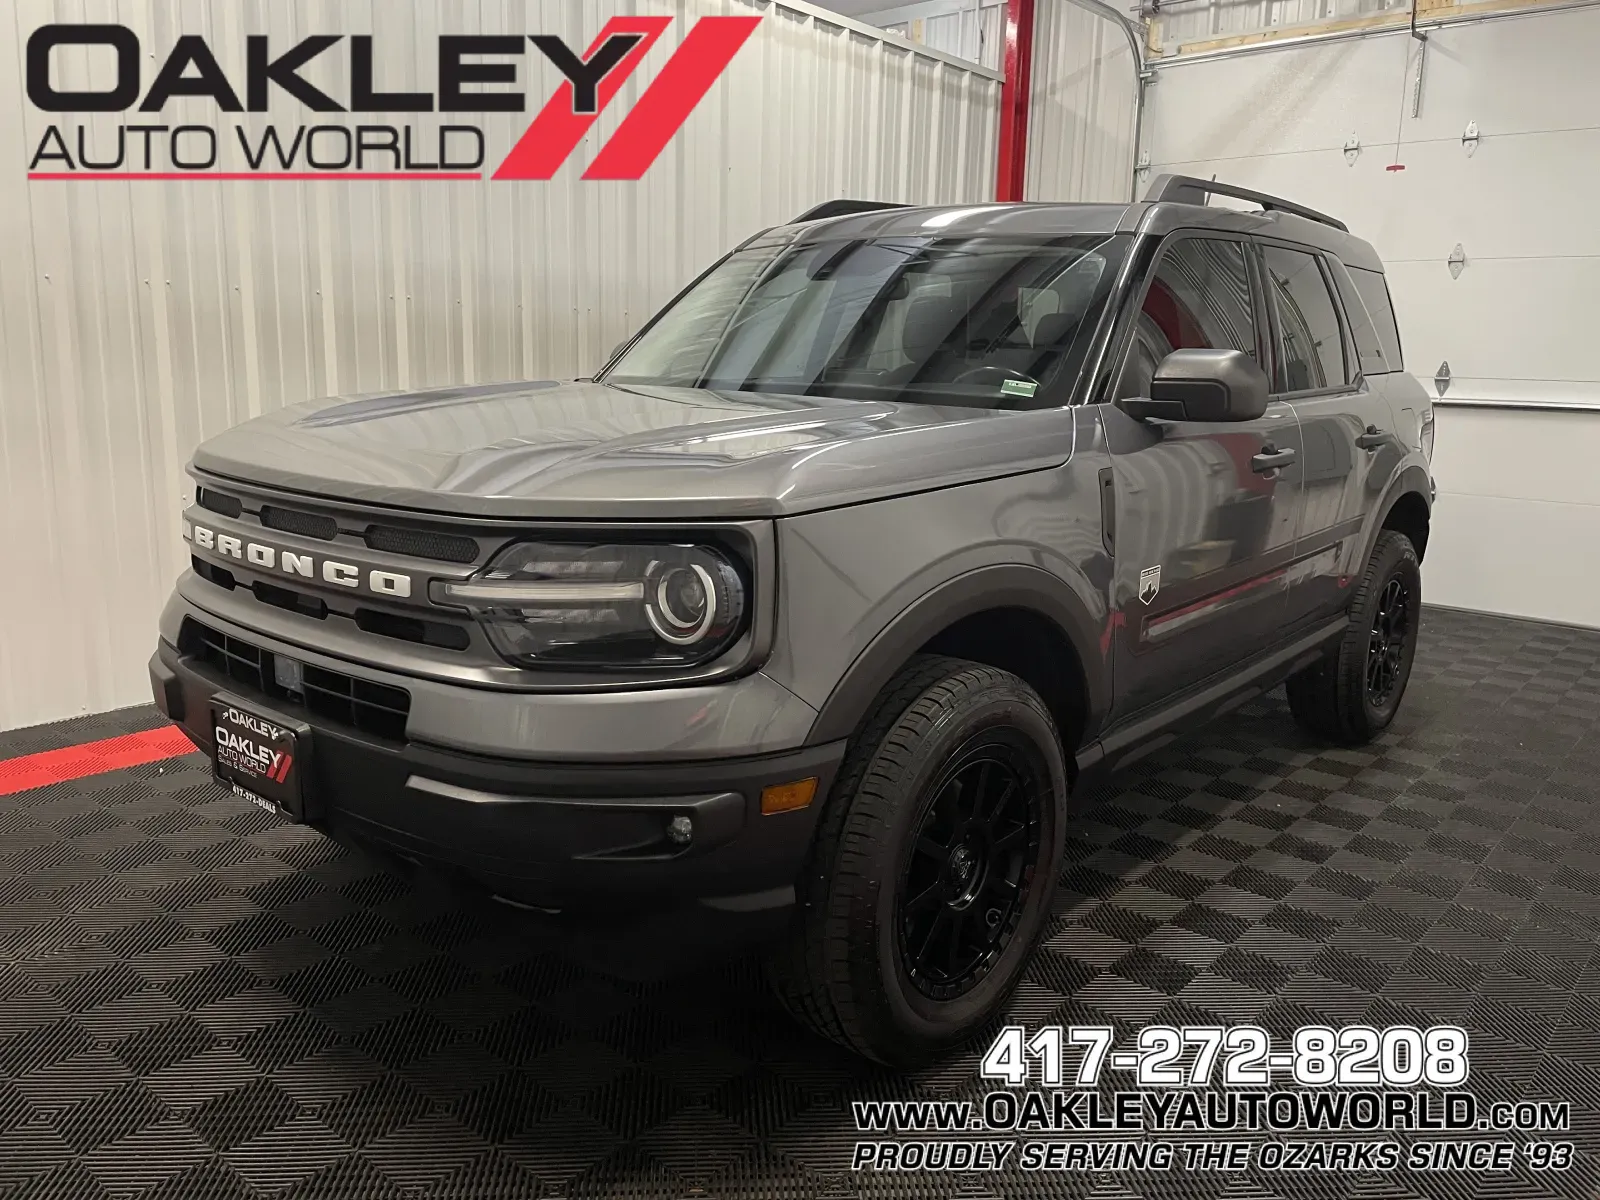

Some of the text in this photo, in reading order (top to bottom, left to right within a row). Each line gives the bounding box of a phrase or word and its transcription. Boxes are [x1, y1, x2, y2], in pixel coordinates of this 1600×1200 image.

[194, 525, 411, 598] BRONCO
[228, 708, 278, 740] OAKLEY
[215, 726, 281, 768] OAKLEY
[218, 745, 267, 773] AUTO WORLD
[232, 785, 276, 814] 417-272-DEALS
